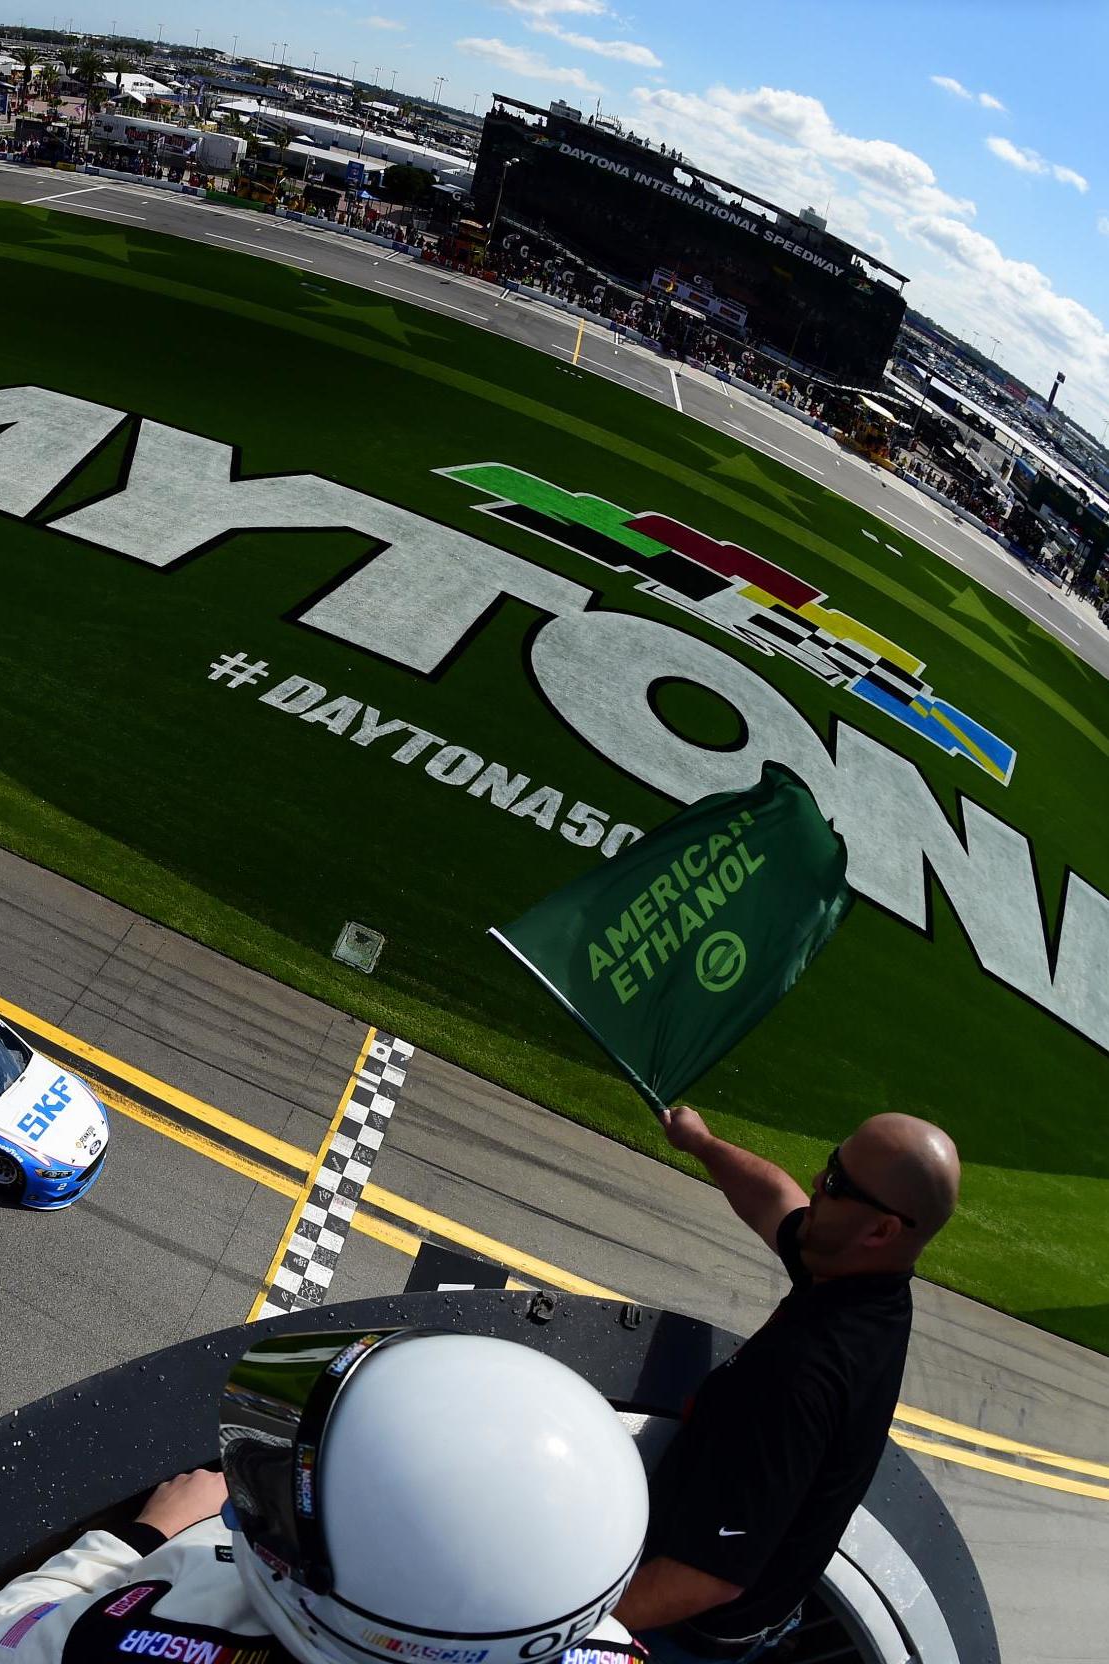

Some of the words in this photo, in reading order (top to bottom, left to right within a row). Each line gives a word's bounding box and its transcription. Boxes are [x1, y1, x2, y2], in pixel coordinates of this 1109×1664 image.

[559, 143, 630, 178] DAYTONA
[634, 172, 759, 235] INTERNATIONAL
[763, 230, 845, 277] SPEEDWAY
[588, 811, 755, 981] AMERICAN
[609, 842, 766, 1004] ETHANOL
[17, 1075, 72, 1142] SKF
[56, 1182, 68, 1191] 2
[119, 1629, 222, 1664] NASCAR
[395, 1641, 491, 1664] NASCAR
